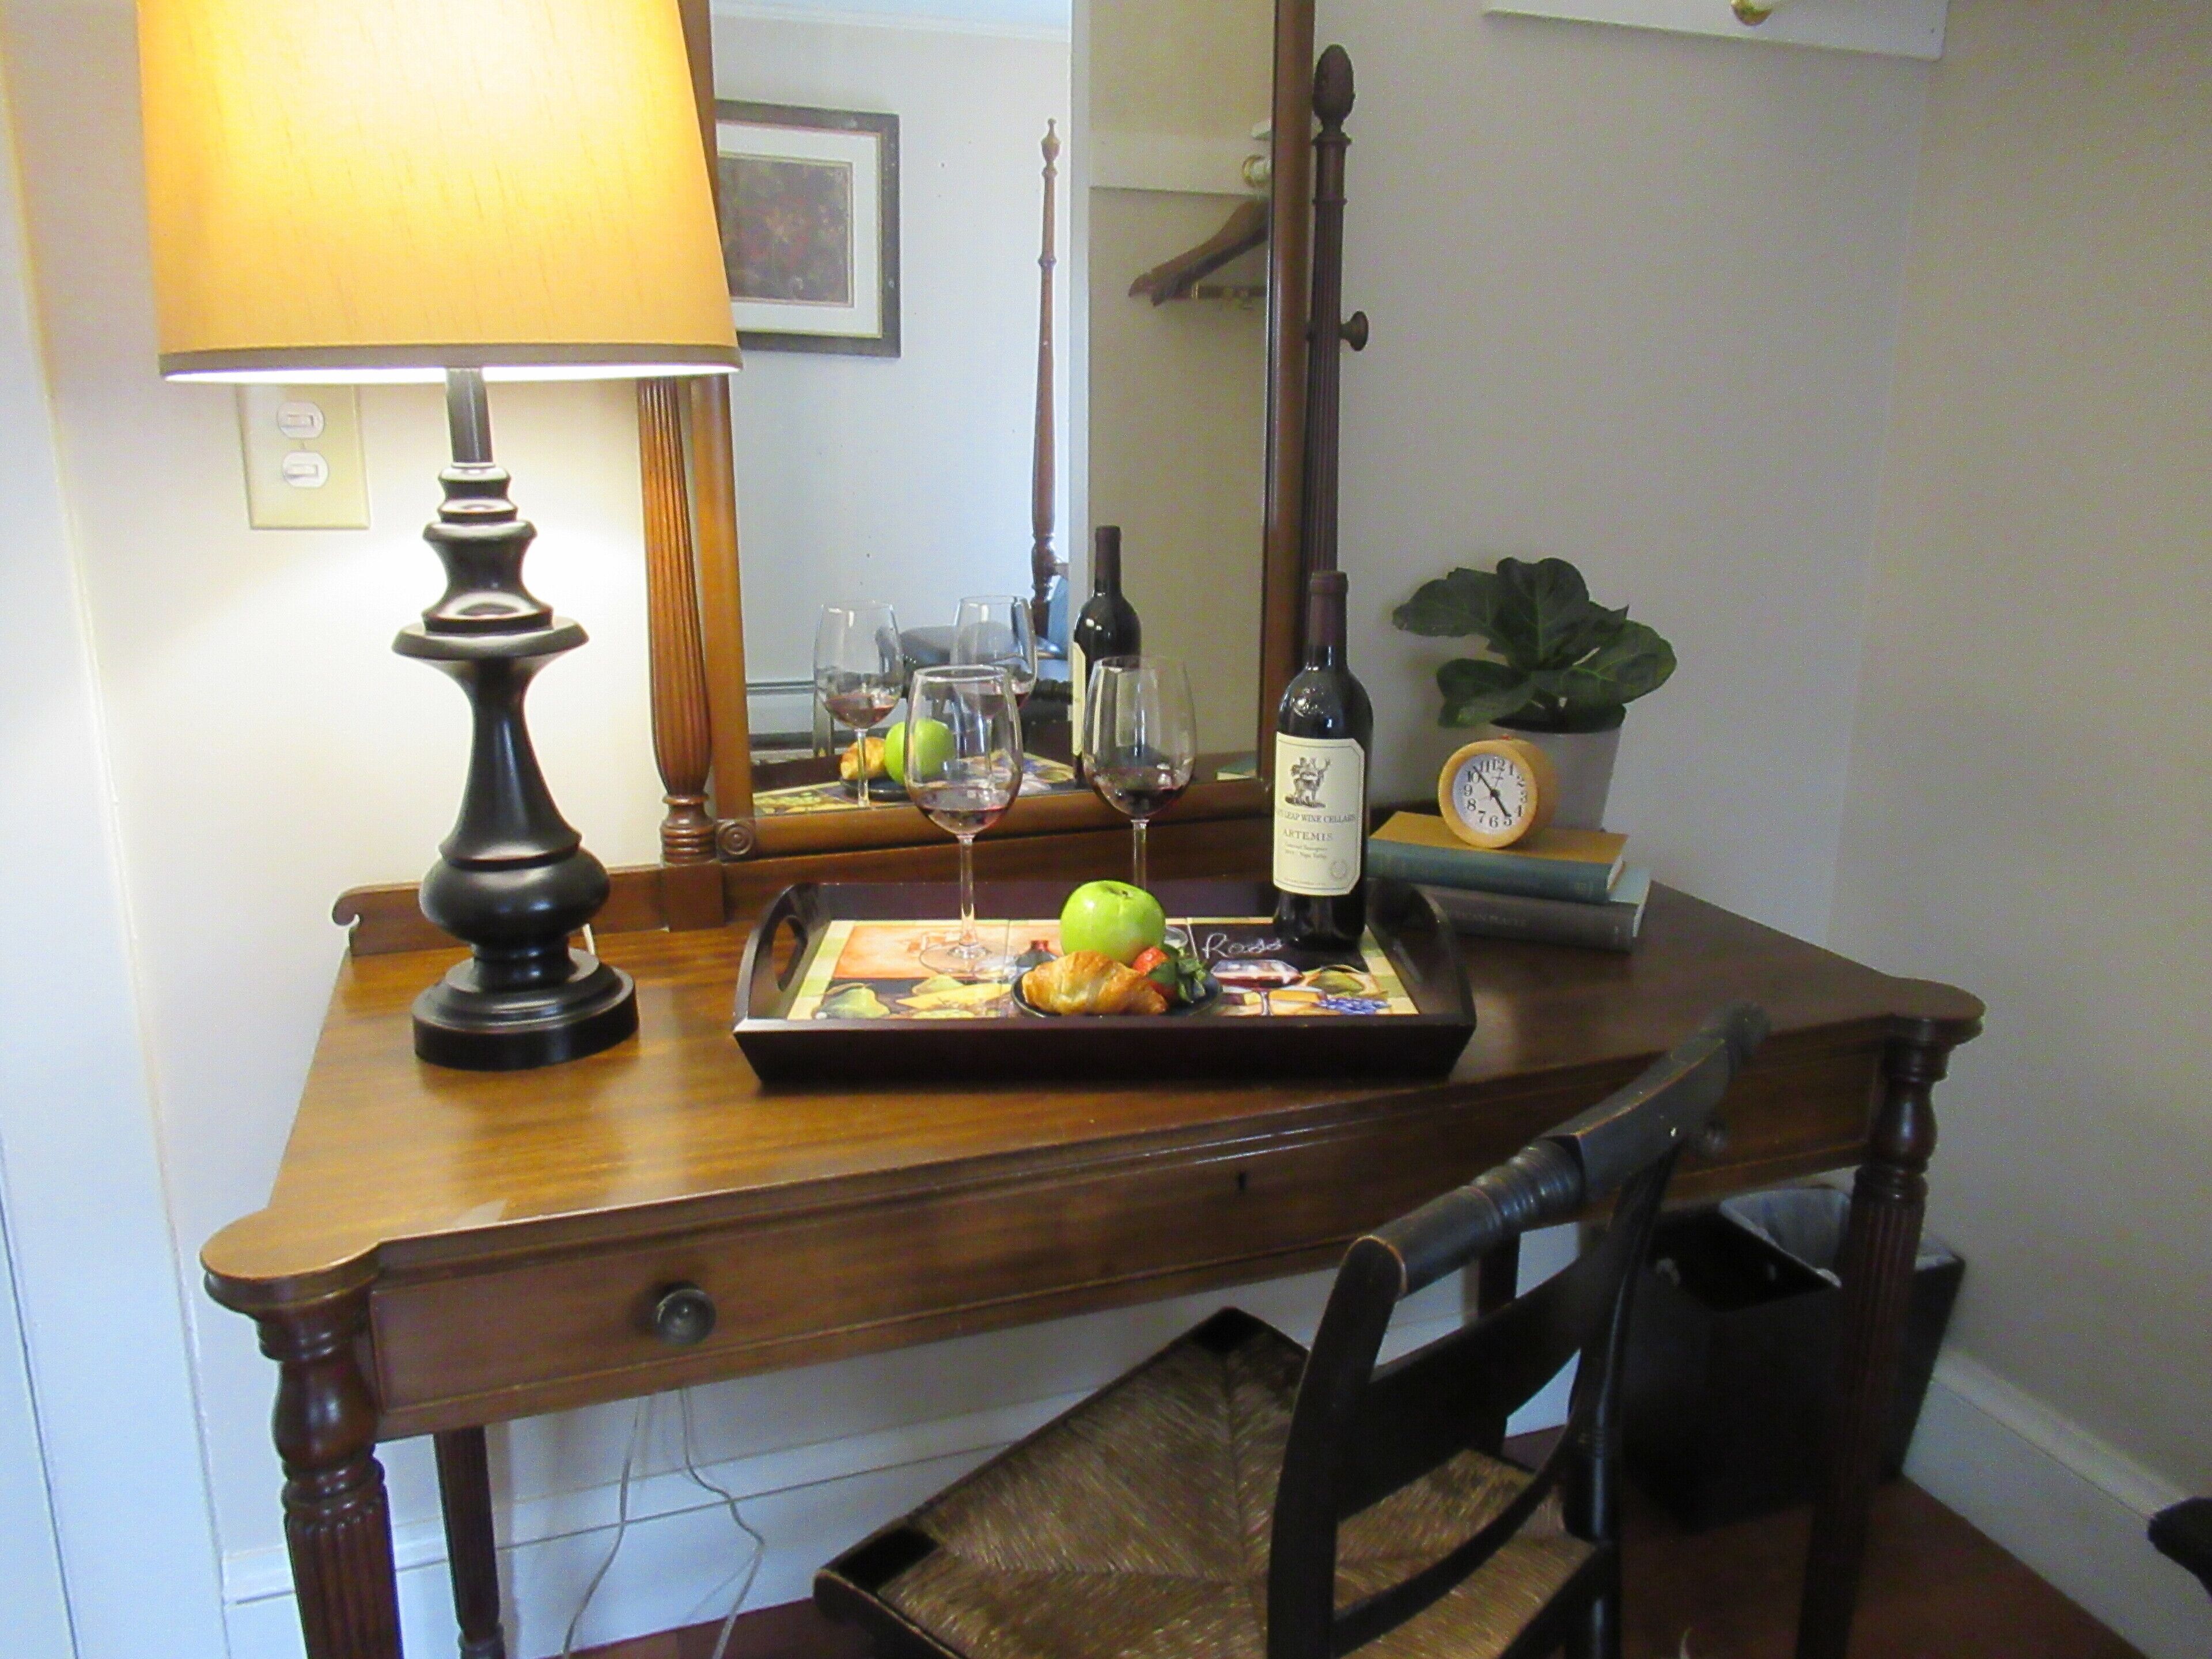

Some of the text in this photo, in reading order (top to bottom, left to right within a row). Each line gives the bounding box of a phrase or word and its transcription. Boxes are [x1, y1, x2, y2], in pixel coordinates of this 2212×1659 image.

[1480, 760, 1490, 772] 11
[1492, 758, 1505, 771] 12
[1509, 763, 1513, 775] 1
[1467, 770, 1480, 783] 10
[1517, 775, 1524, 787] 2
[1464, 783, 1472, 797] 9
[1520, 790, 1528, 803] 3
[1467, 798, 1476, 810] 8
[1285, 811, 1300, 821] LEAP
[1301, 813, 1321, 823] WINE
[1323, 813, 1356, 823] CELLARS
[1478, 810, 1486, 823] 7
[1489, 815, 1498, 828] 6
[1283, 828, 1333, 841] ARTEMIS
